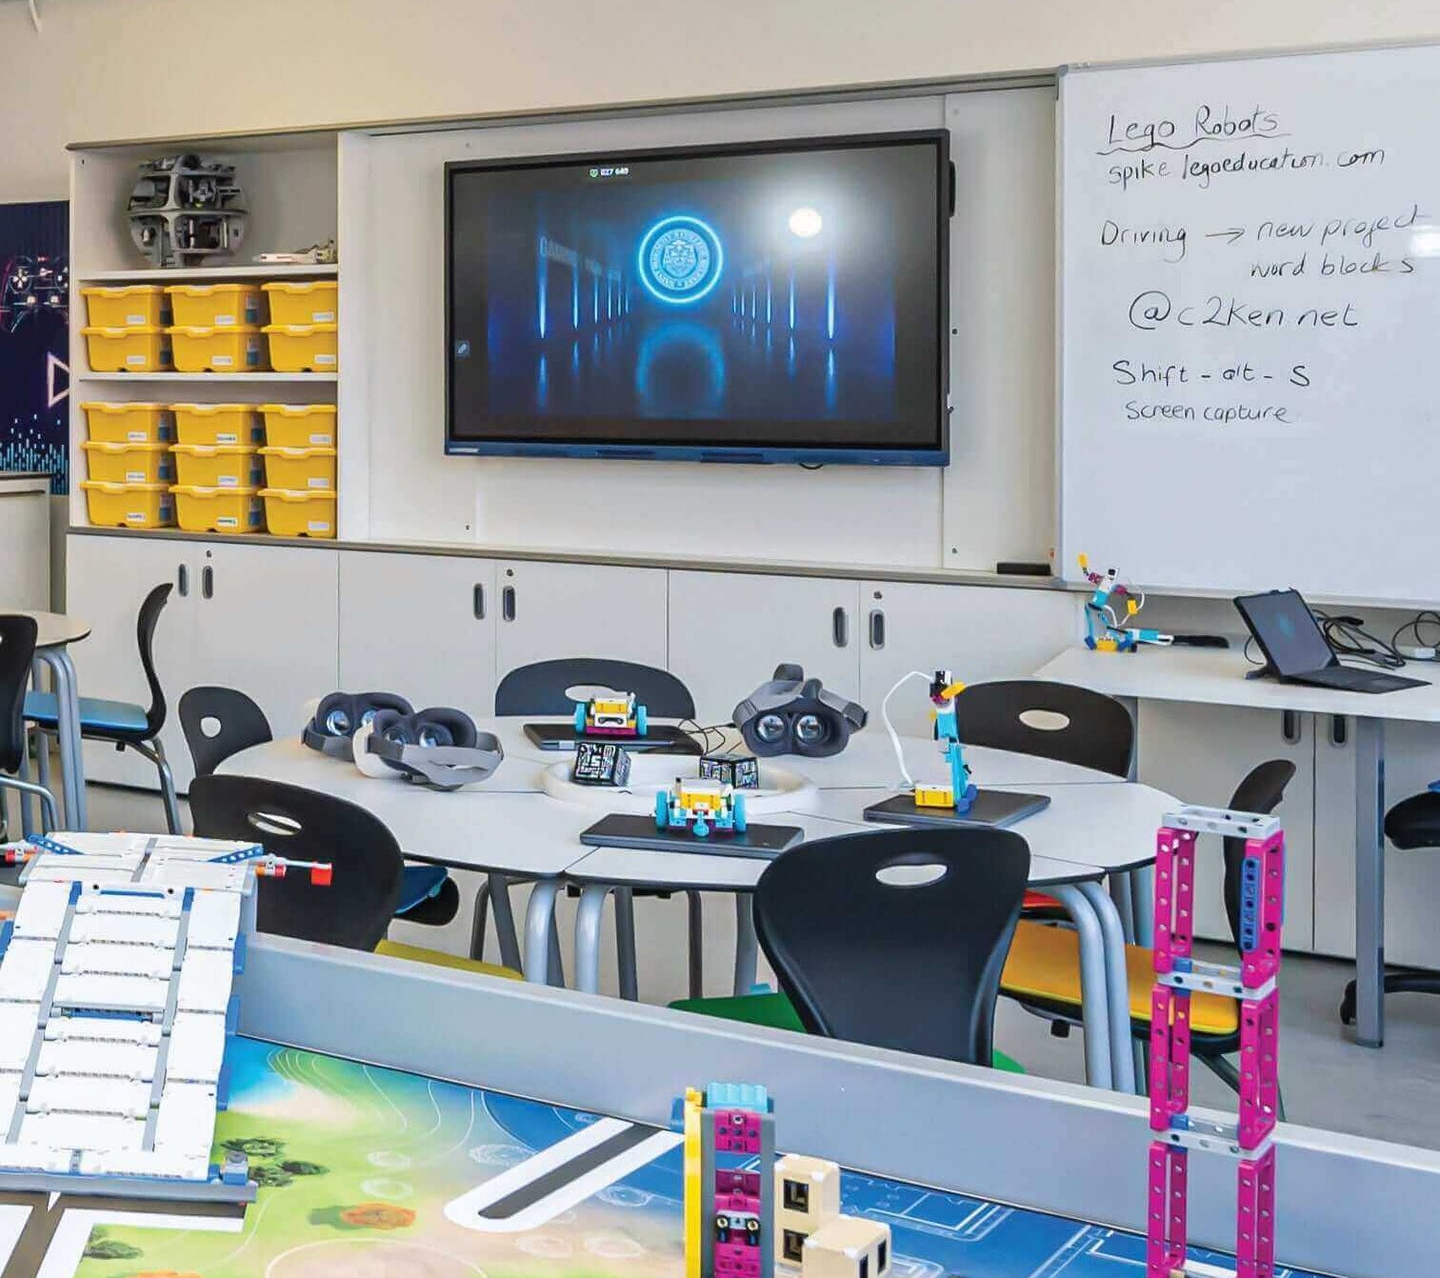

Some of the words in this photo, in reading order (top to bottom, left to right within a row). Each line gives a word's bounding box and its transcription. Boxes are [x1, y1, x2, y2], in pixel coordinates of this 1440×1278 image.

[1108, 115, 1175, 149] Lego
[1195, 105, 1279, 137] Robots
[1100, 220, 1188, 262] Driving
[1257, 221, 1311, 241] new
[1321, 204, 1431, 248] project
[1251, 252, 1306, 277] word
[1321, 253, 1415, 275] blocks
[1112, 360, 1189, 387] Shift
[1125, 401, 1196, 421] Screen
[1203, 401, 1292, 423] capture
